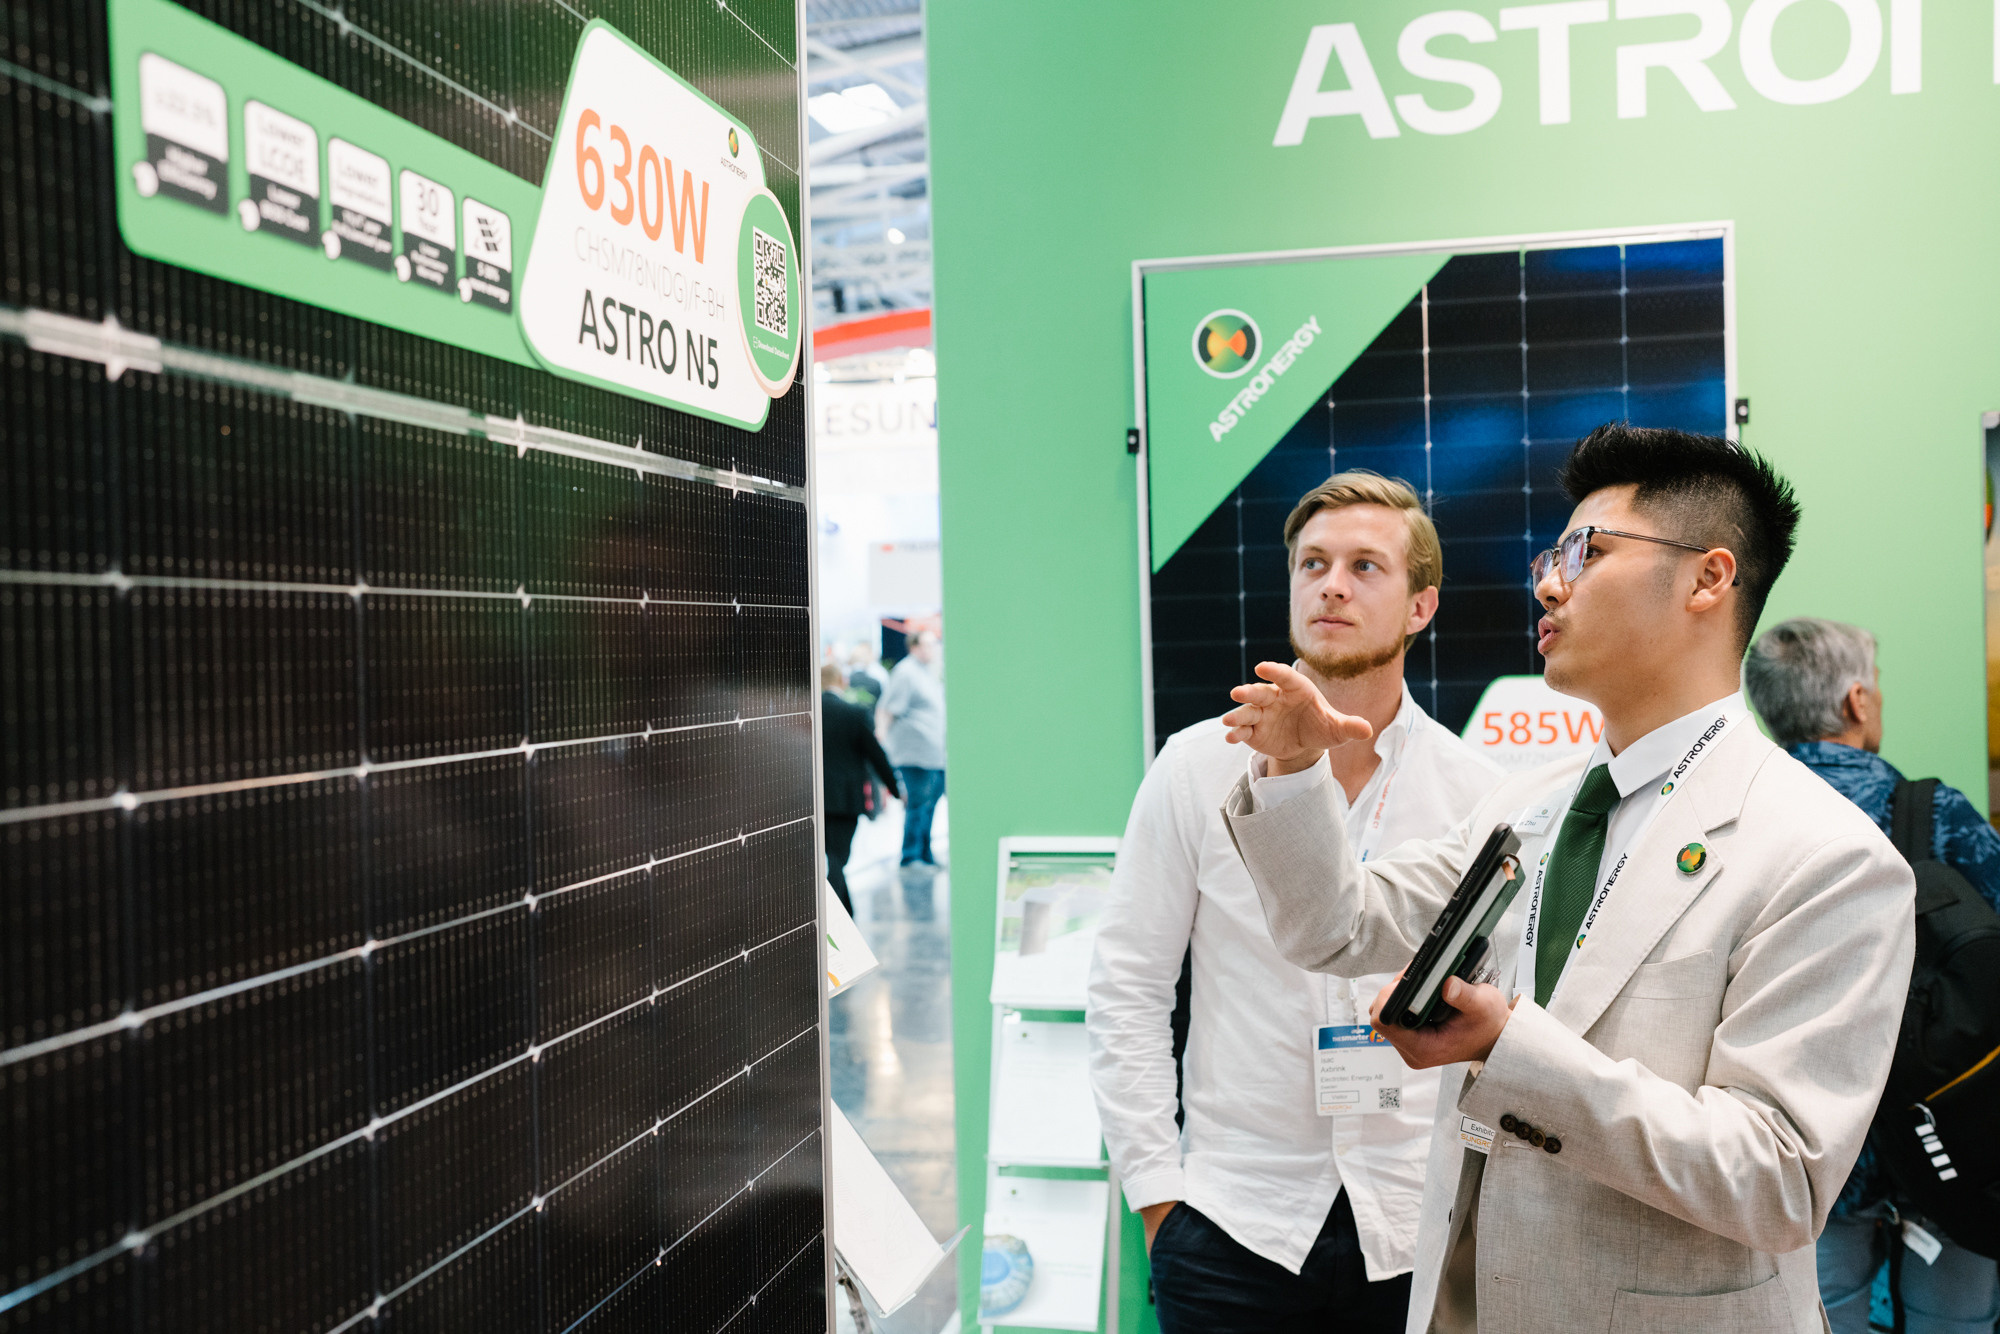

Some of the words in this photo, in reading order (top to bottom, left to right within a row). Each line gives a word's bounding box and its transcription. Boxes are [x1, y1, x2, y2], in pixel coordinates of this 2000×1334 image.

[418, 181, 439, 217] 30
[576, 108, 710, 264] 630W
[579, 289, 677, 375] ASTRO
[686, 328, 719, 389] N5
[1209, 315, 1322, 442] ASTRONERGY
[1483, 711, 1605, 746] 585W
[1673, 714, 1728, 779] ASTRONERGY
[1525, 870, 1543, 947] ASTRONERGY
[1585, 853, 1629, 930] ASTRONERGY
[1460, 1133, 1492, 1148] SUNGRO
[1470, 1123, 1494, 1137] Exhibito
